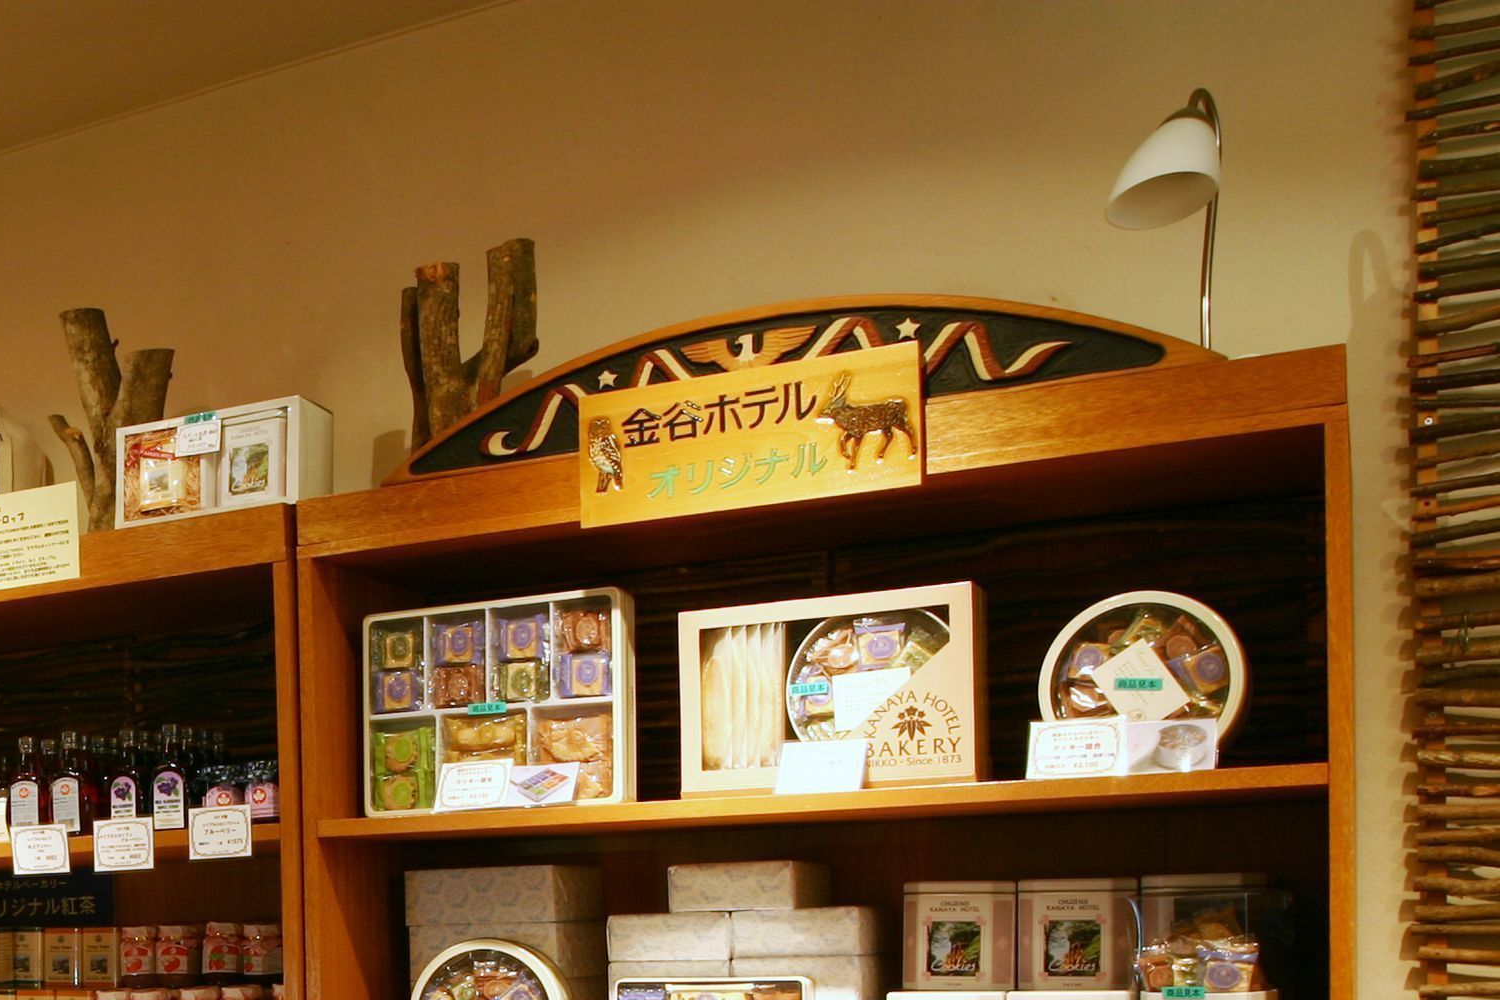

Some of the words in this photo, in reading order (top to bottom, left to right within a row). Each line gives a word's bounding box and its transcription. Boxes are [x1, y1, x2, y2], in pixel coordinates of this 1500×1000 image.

[621, 380, 817, 448] 金谷ホテル
[648, 441, 828, 498] オリジナル
[792, 682, 826, 695] 商品見本
[864, 690, 918, 738] KANAYA
[923, 691, 962, 735] HOTEL
[866, 737, 961, 758] BAKERY
[906, 757, 933, 767] Since
[938, 755, 962, 765] 1873
[930, 956, 976, 972] Cookies
[1048, 956, 1097, 972] Cookies
[1166, 988, 1201, 997] 商品見本
